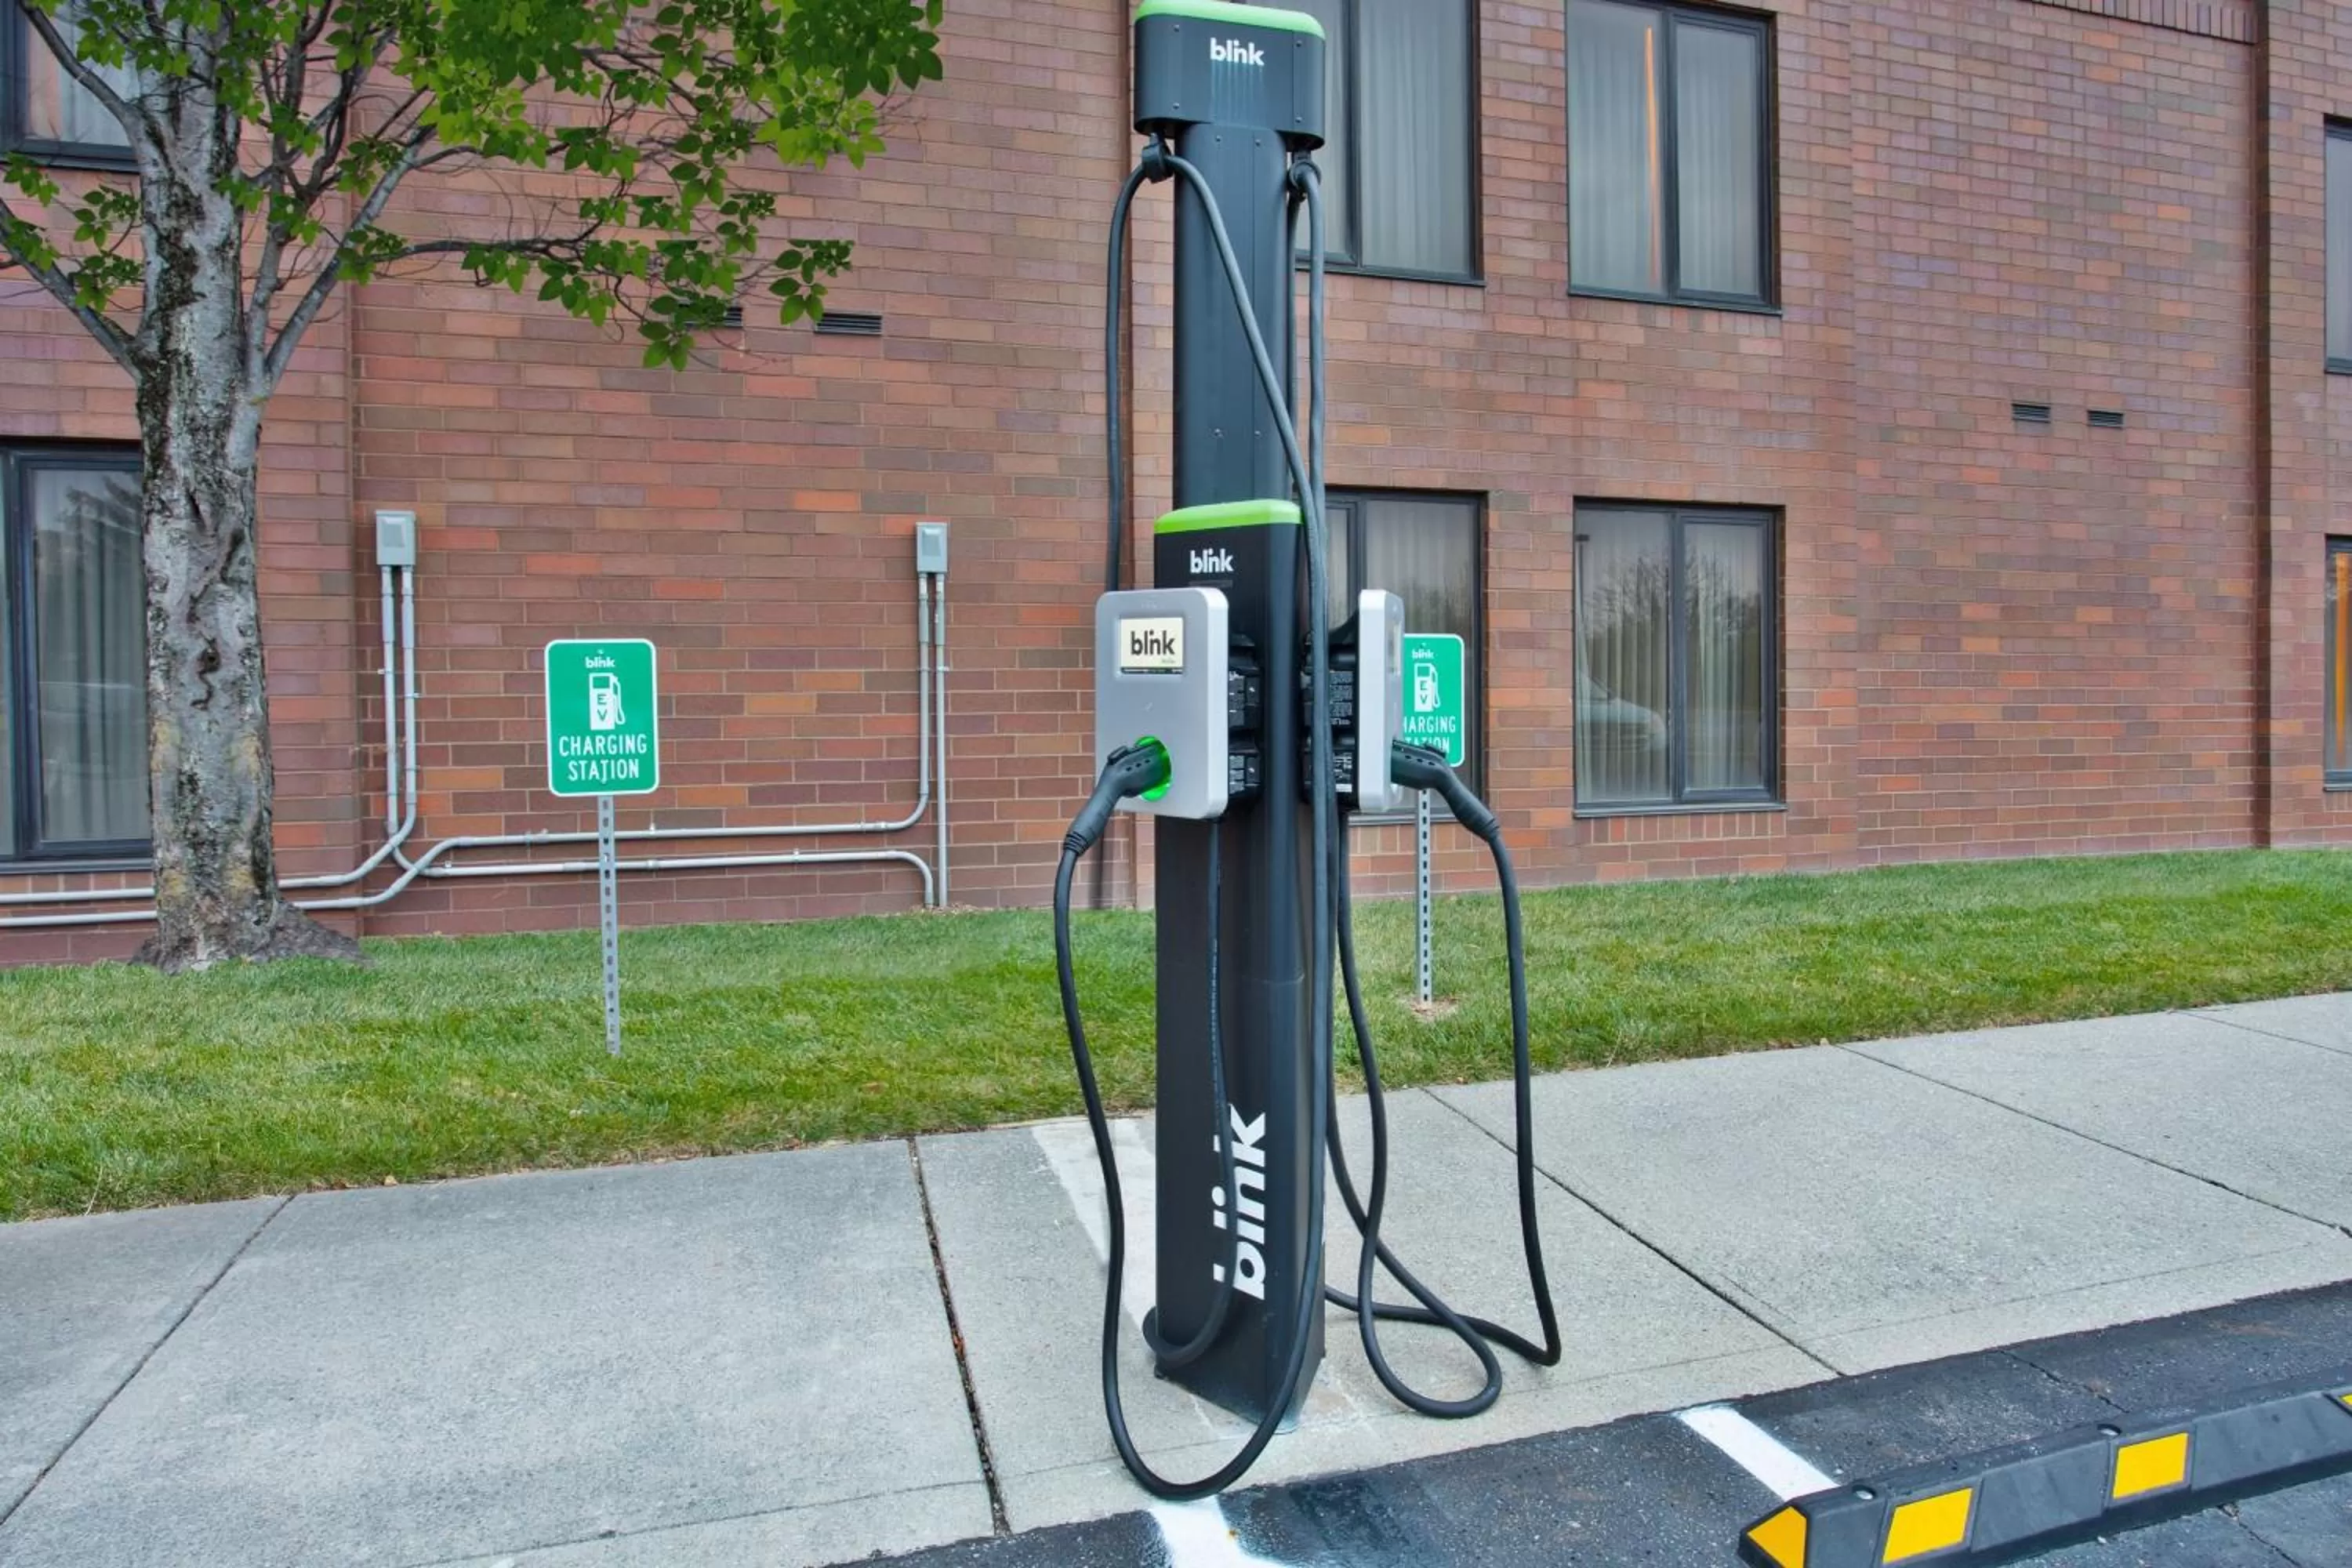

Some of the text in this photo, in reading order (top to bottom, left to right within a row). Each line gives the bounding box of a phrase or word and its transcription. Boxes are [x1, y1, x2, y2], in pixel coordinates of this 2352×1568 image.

[1210, 37, 1265, 67] blink
[1190, 548, 1234, 574] blink
[1131, 629, 1176, 655] blink
[1411, 649, 1435, 659] blink
[585, 656, 615, 669] blink
[559, 734, 648, 757] CHARGING
[568, 758, 640, 782] STATION
[1211, 1102, 1266, 1301] blink
